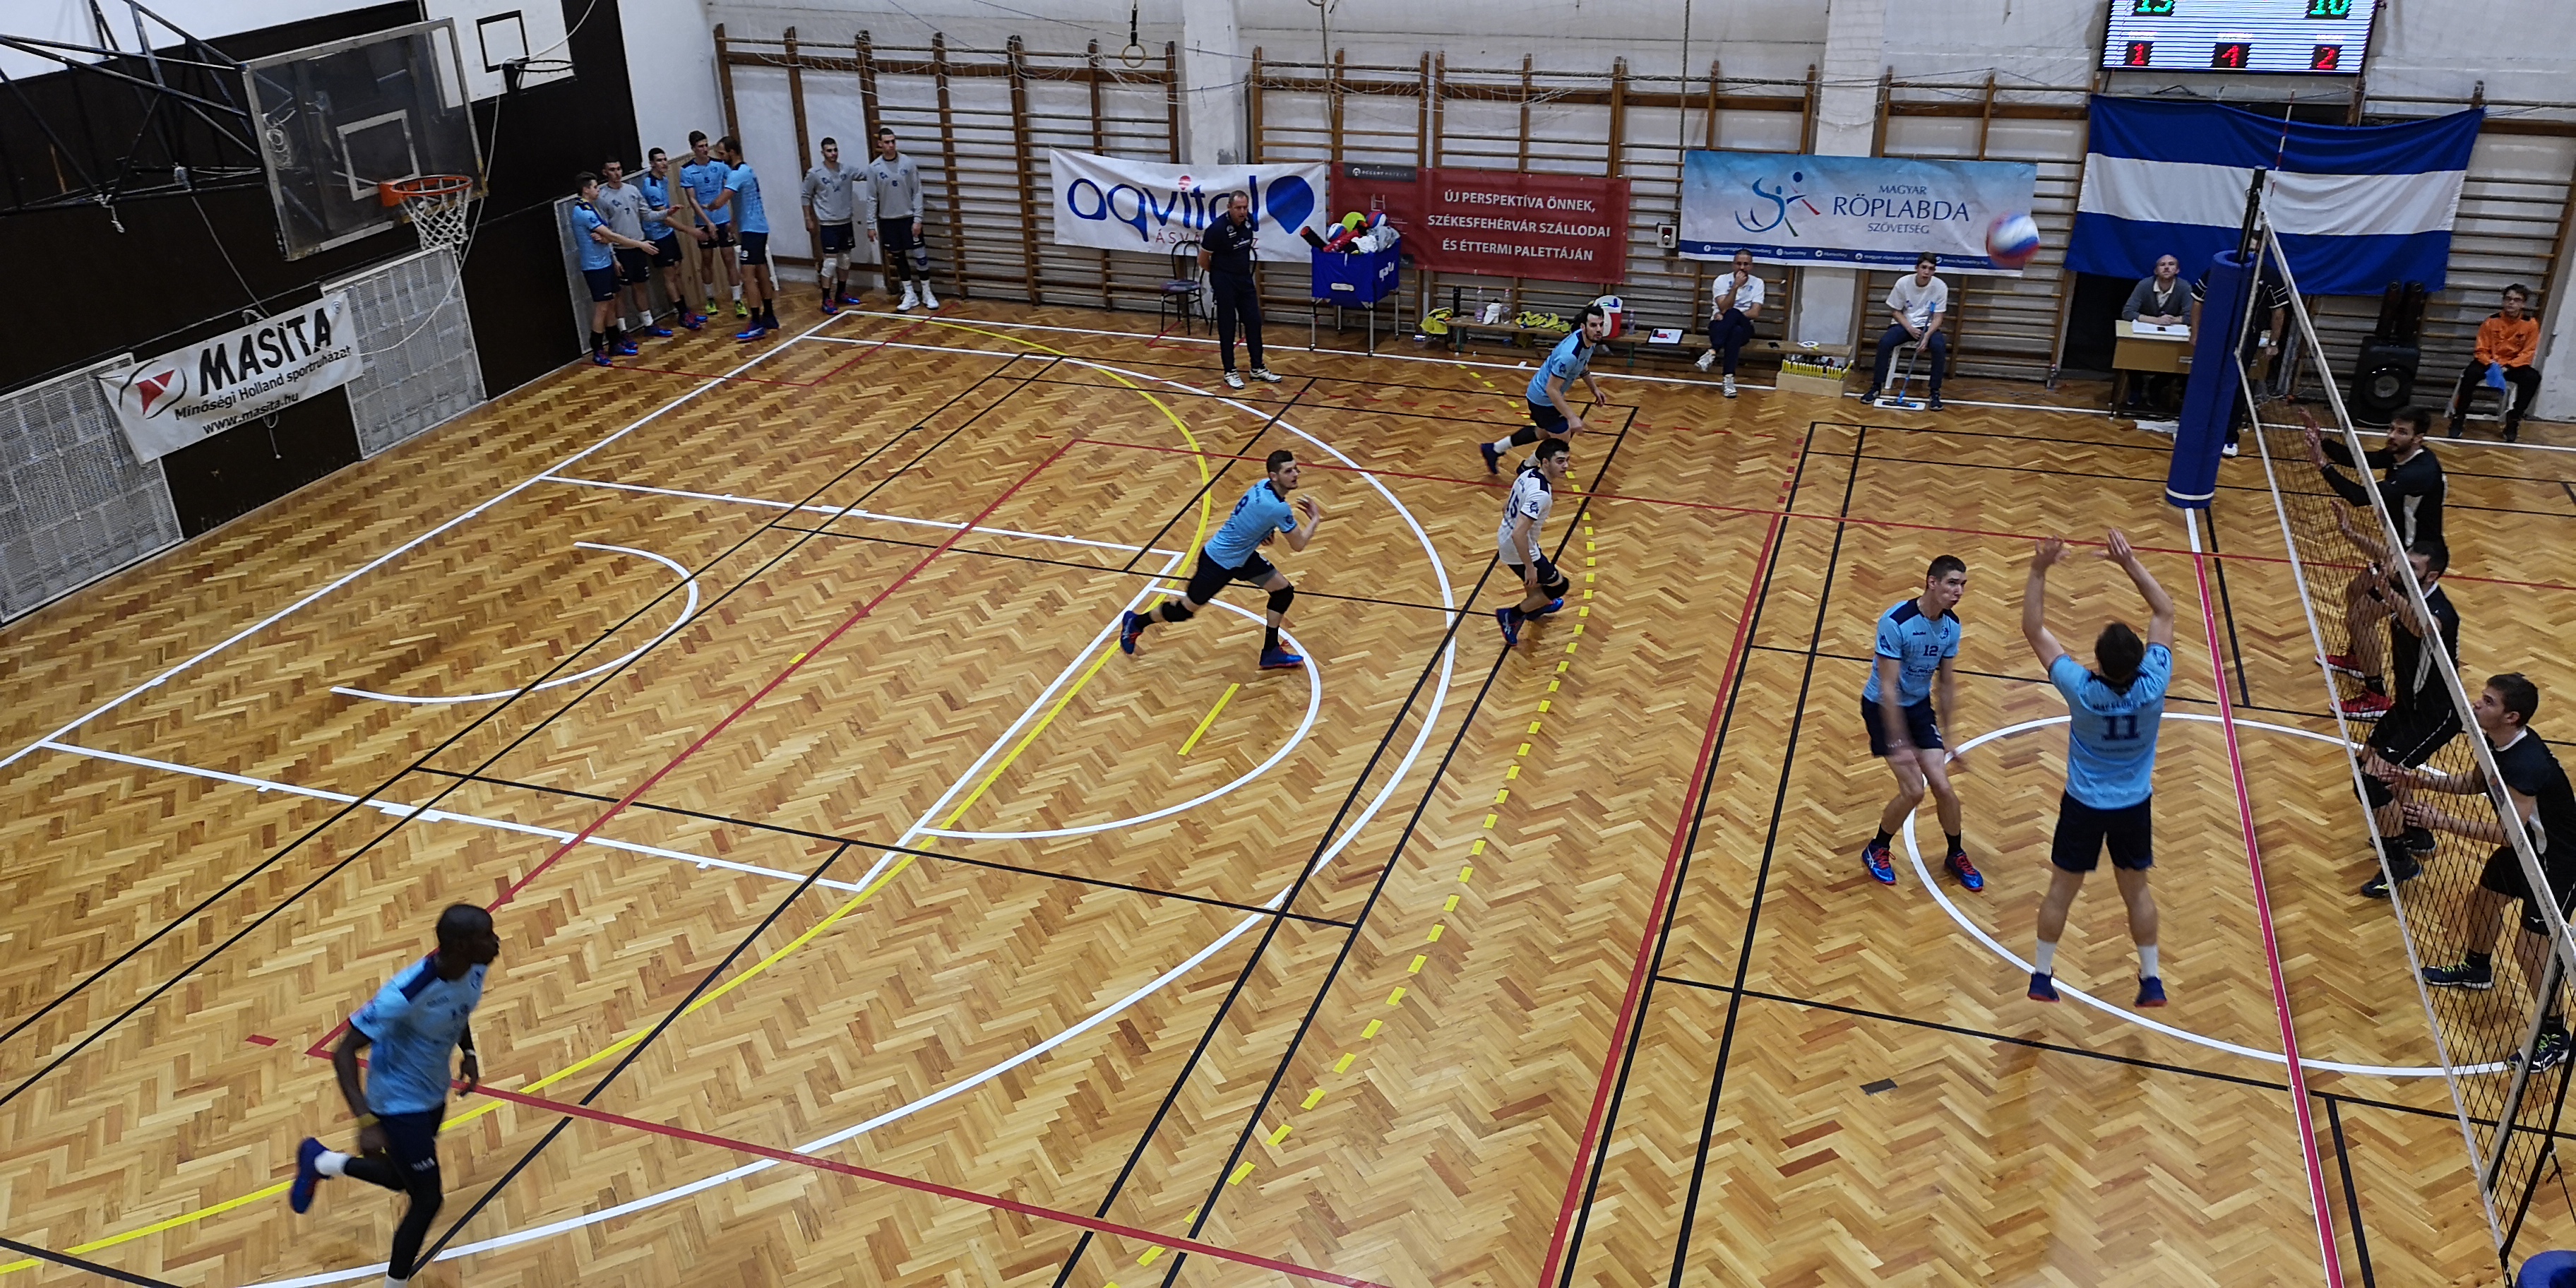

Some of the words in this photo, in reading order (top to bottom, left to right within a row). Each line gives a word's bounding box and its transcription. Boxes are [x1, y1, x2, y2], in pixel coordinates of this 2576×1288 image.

[2316, 47, 2336, 69] 2
[1444, 189, 1460, 203] ÚJ
[1462, 192, 1544, 209] PERSPEKTÍVA
[1546, 196, 1596, 213] ÖNNEK,
[1878, 184, 1927, 196] MAGYAR
[1833, 194, 1969, 222] RÖPLABDA
[1428, 213, 1537, 233] SZÉKESFEHÉRVÁR
[1539, 221, 1611, 237] SZÁLLODAI
[1868, 222, 1930, 234] SZÖVETSÉG
[1442, 238, 1457, 251] ÉS
[1460, 239, 1513, 255] ÉTTERMI
[1515, 244, 1593, 261] PALETTÁJÁN
[199, 307, 331, 397] MASITA
[239, 373, 285, 401] Holland
[203, 392, 299, 434] www.masita.hu
[1923, 645, 1939, 657] 12
[2102, 715, 2141, 741] 11
